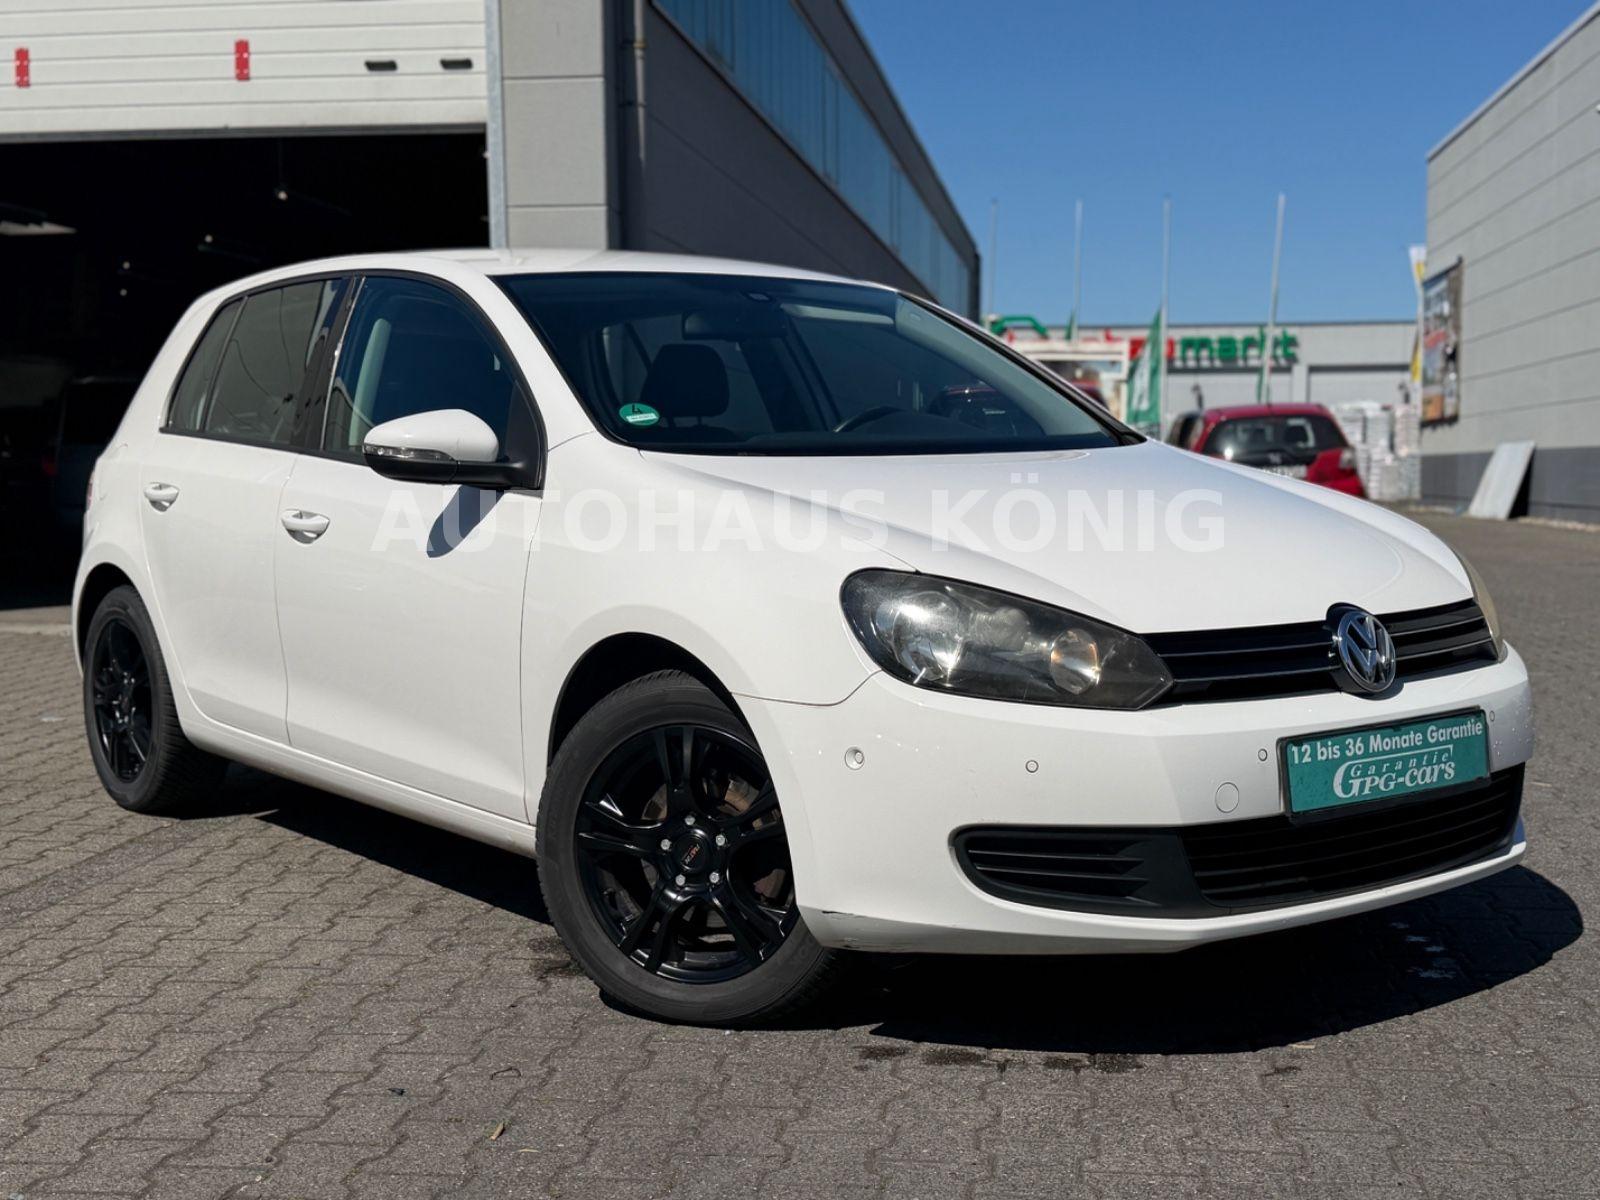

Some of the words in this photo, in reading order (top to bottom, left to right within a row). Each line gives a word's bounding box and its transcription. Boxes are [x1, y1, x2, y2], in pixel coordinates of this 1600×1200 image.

[1292, 744, 1312, 764] 12
[1317, 741, 1341, 761] bis
[1345, 737, 1364, 756] 36
[1369, 731, 1423, 753] Monate
[1427, 718, 1483, 743] Garantie
